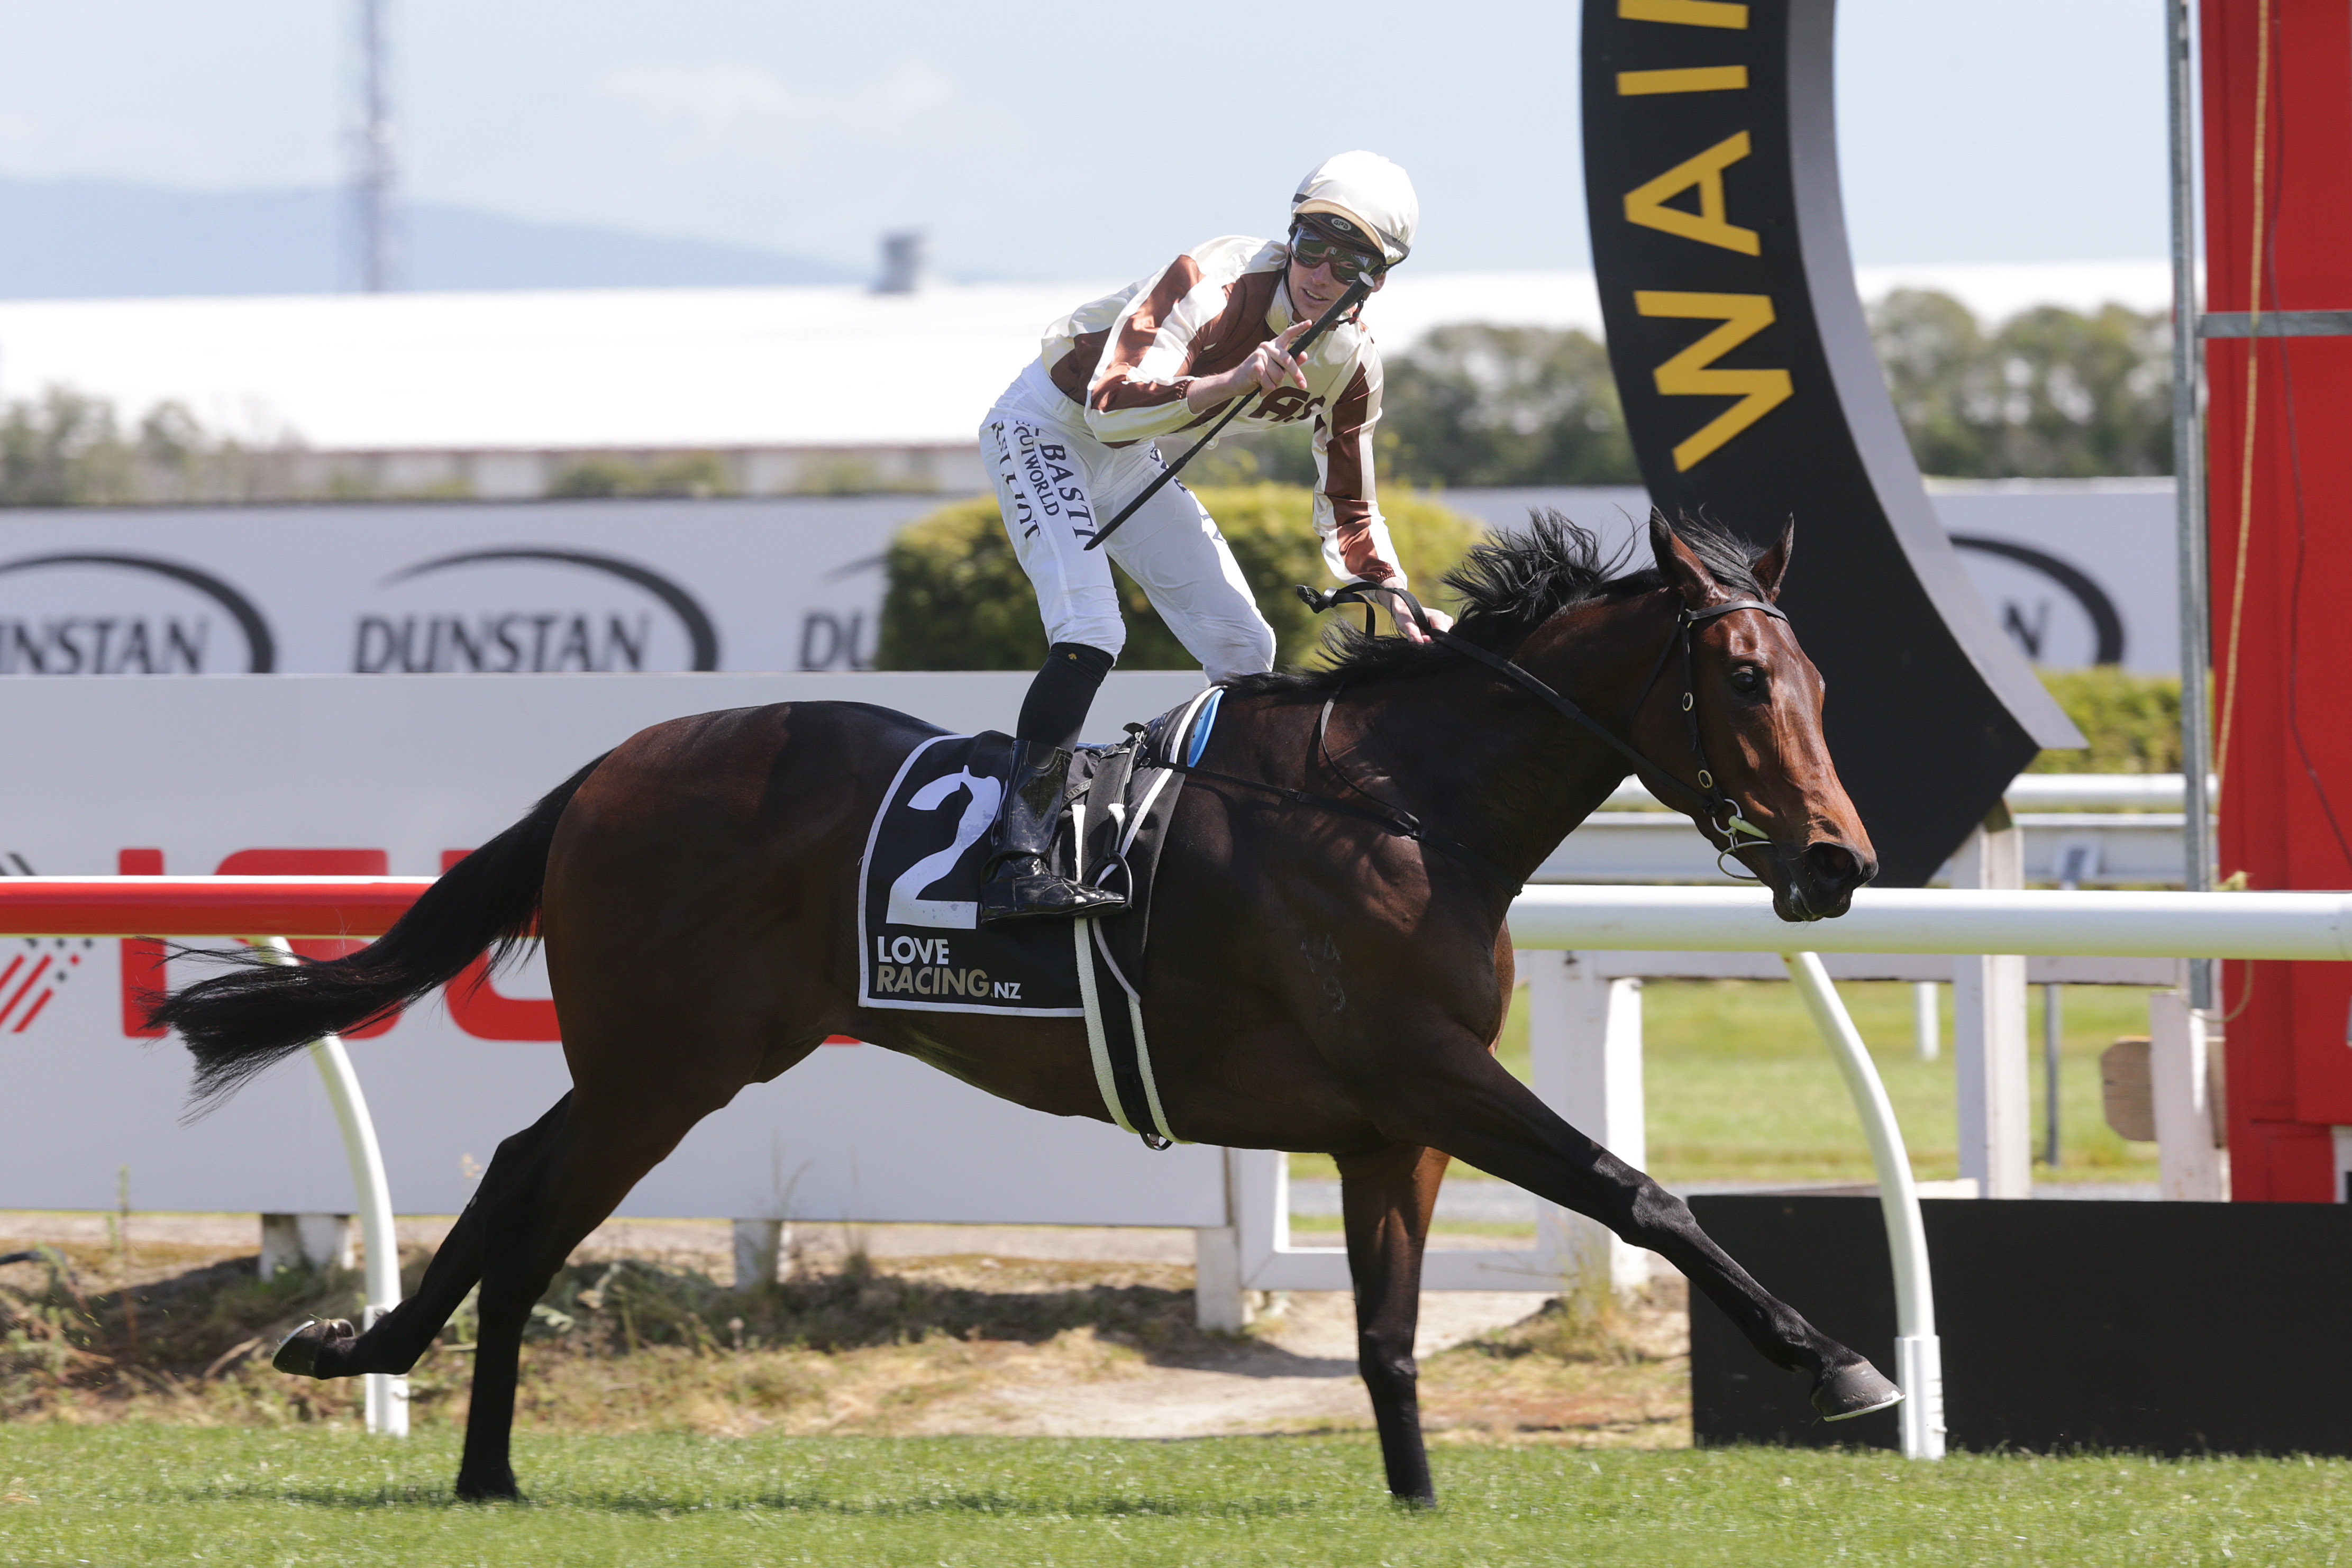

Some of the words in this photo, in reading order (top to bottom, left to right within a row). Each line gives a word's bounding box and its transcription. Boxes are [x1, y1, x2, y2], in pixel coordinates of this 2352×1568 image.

[0, 613, 208, 673] NSTAN
[353, 613, 649, 672] DUNSTAN
[886, 764, 1001, 929] 2
[877, 936, 949, 965] LOVE
